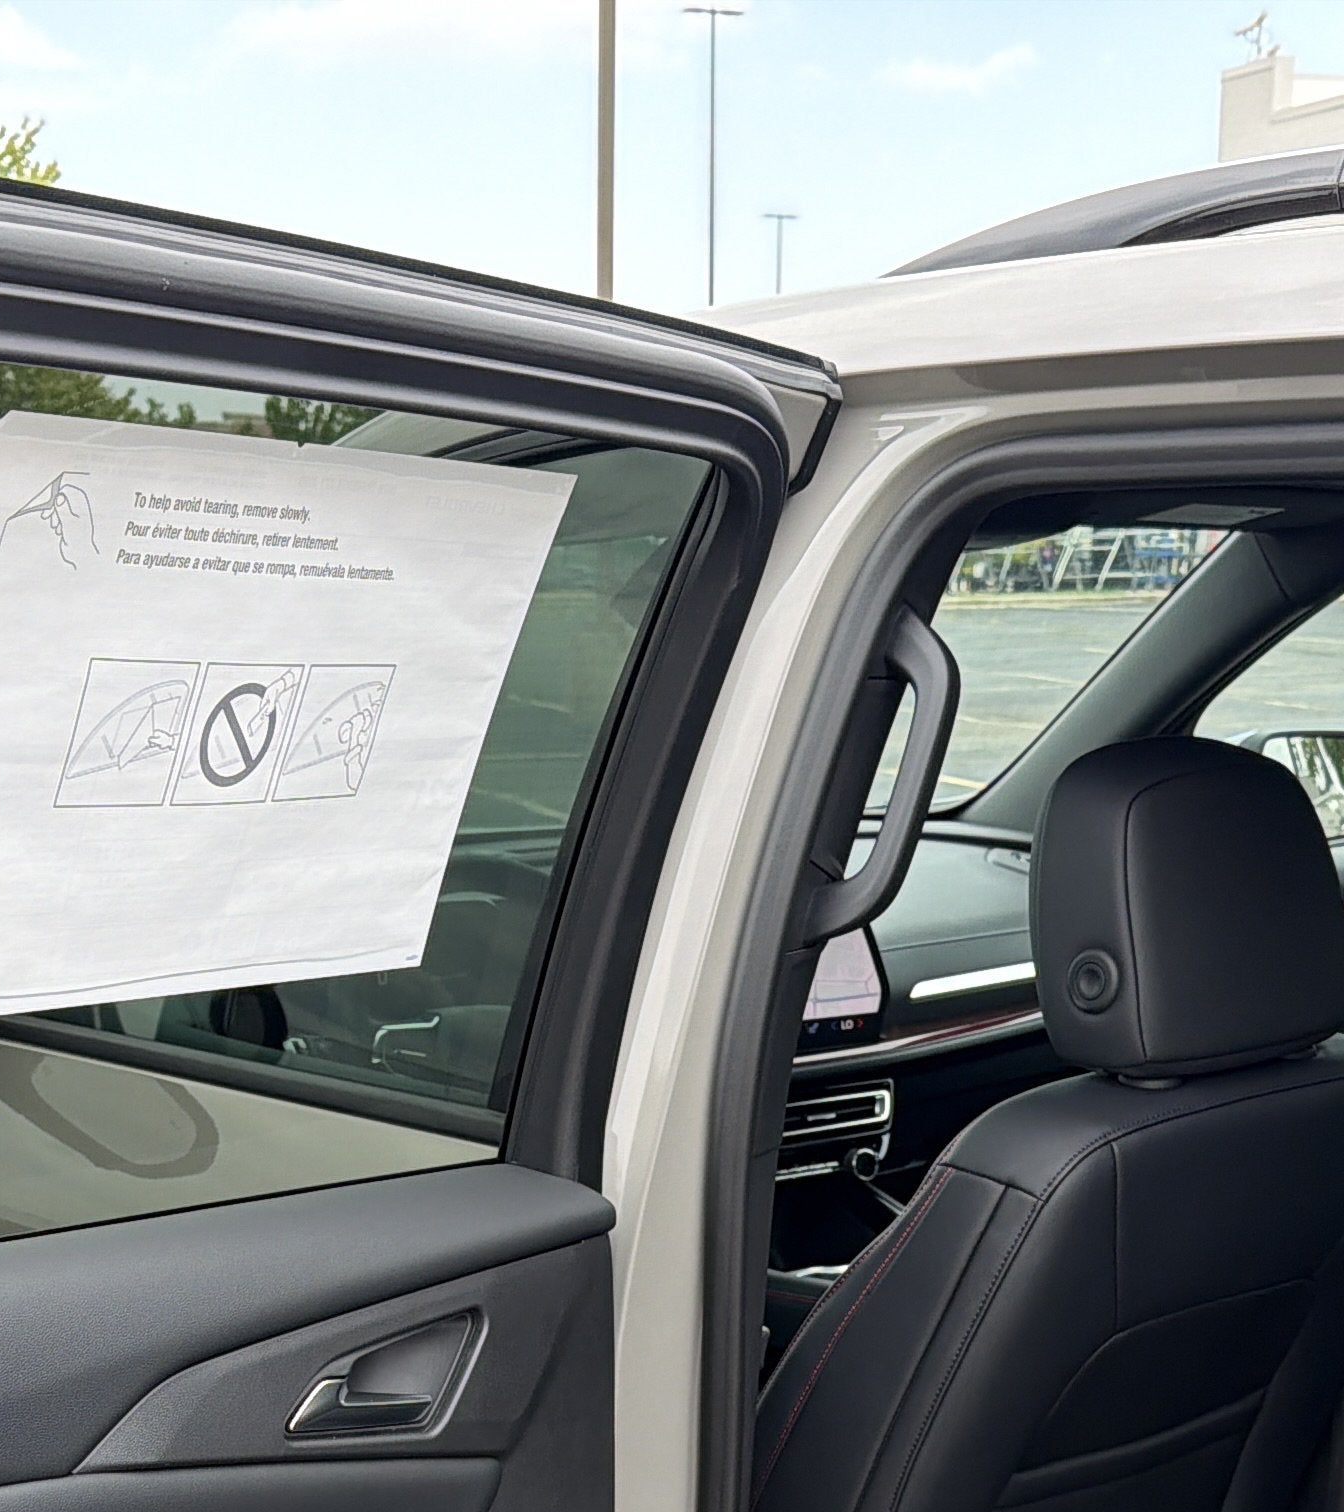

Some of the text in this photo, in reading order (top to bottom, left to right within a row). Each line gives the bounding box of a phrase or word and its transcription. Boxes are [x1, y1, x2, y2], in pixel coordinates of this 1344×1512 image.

[134, 491, 311, 524] To help avoid tearing, remove slowly.
[124, 521, 339, 551] Pour éviter toute déchirure, retirer lentement.
[116, 549, 395, 581] Para ayudarse a evitar que se rompa, remuévala lentamente.
